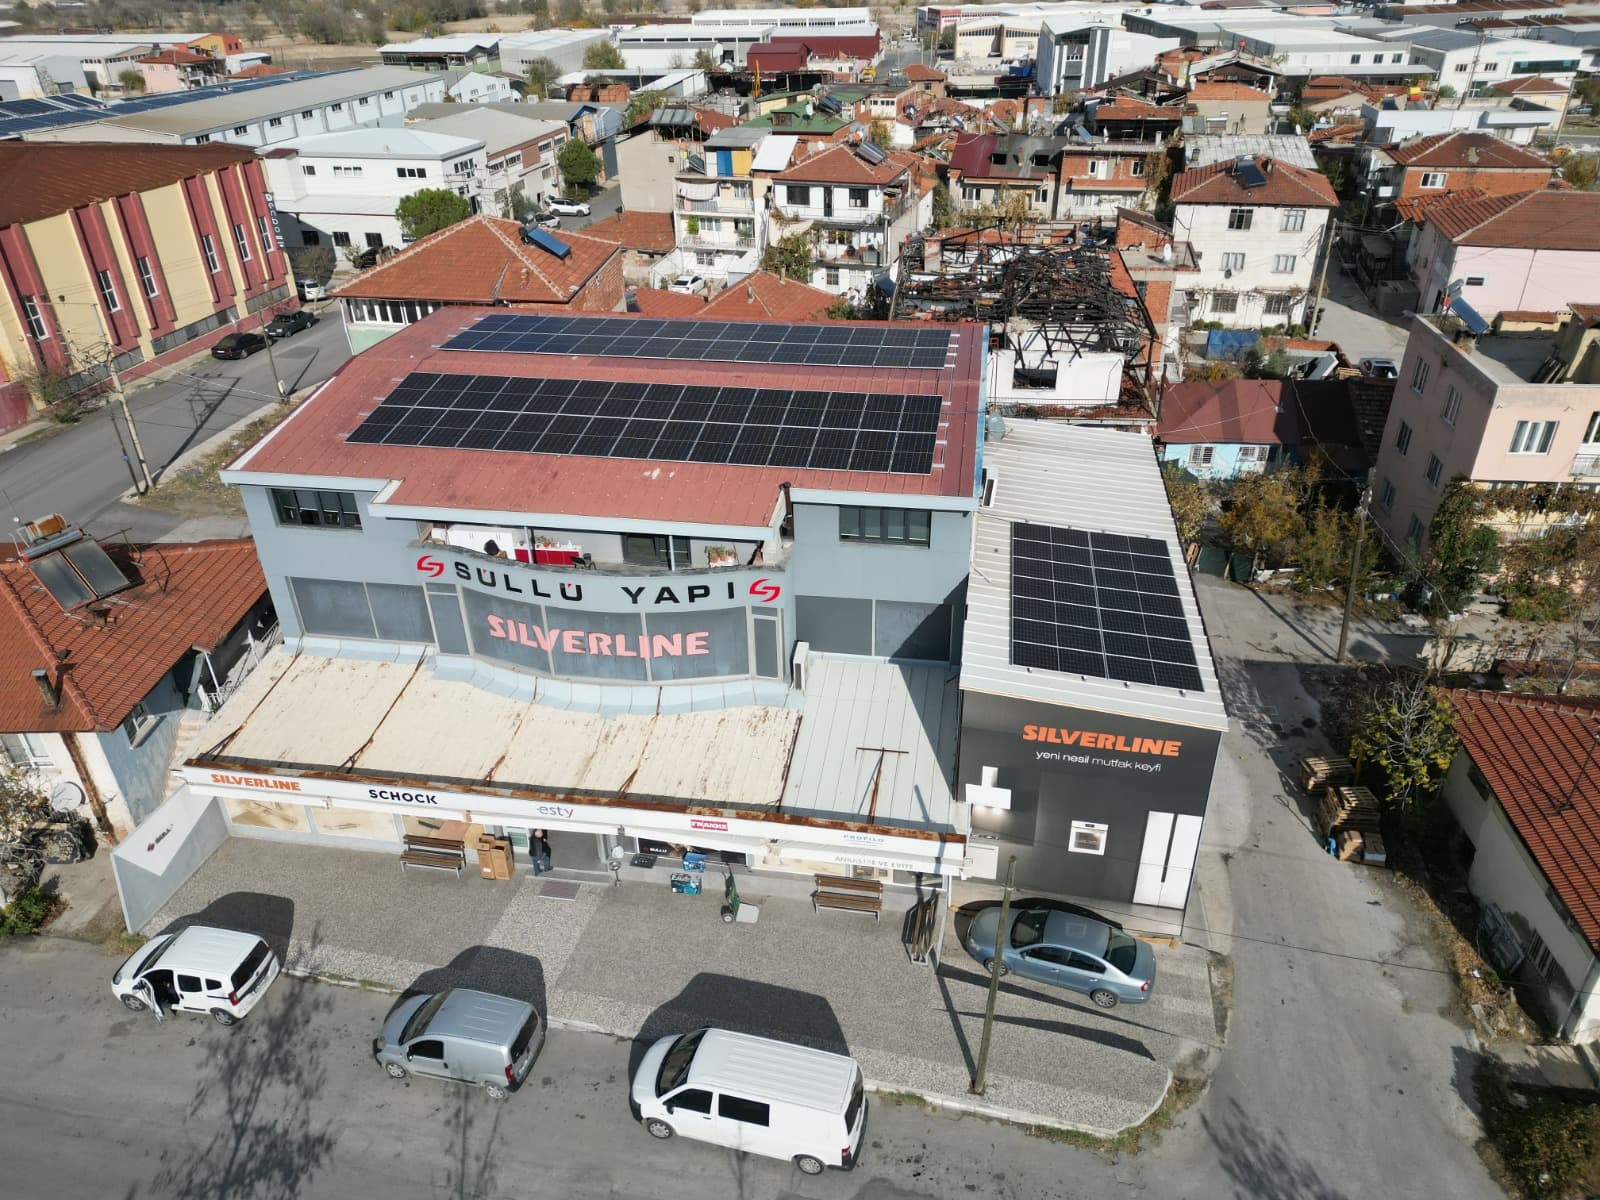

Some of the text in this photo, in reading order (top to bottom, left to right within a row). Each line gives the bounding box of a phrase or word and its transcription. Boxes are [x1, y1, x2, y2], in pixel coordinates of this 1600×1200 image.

[454, 561, 735, 605] SÜLLÜ YAPI
[486, 613, 710, 659] SILVERLINE
[1022, 724, 1183, 757] SILVERLINE
[1035, 750, 1162, 773] yeni nesil mutfak keyfi
[210, 773, 301, 791] SILVERLINE
[368, 789, 438, 805] SCHOCK
